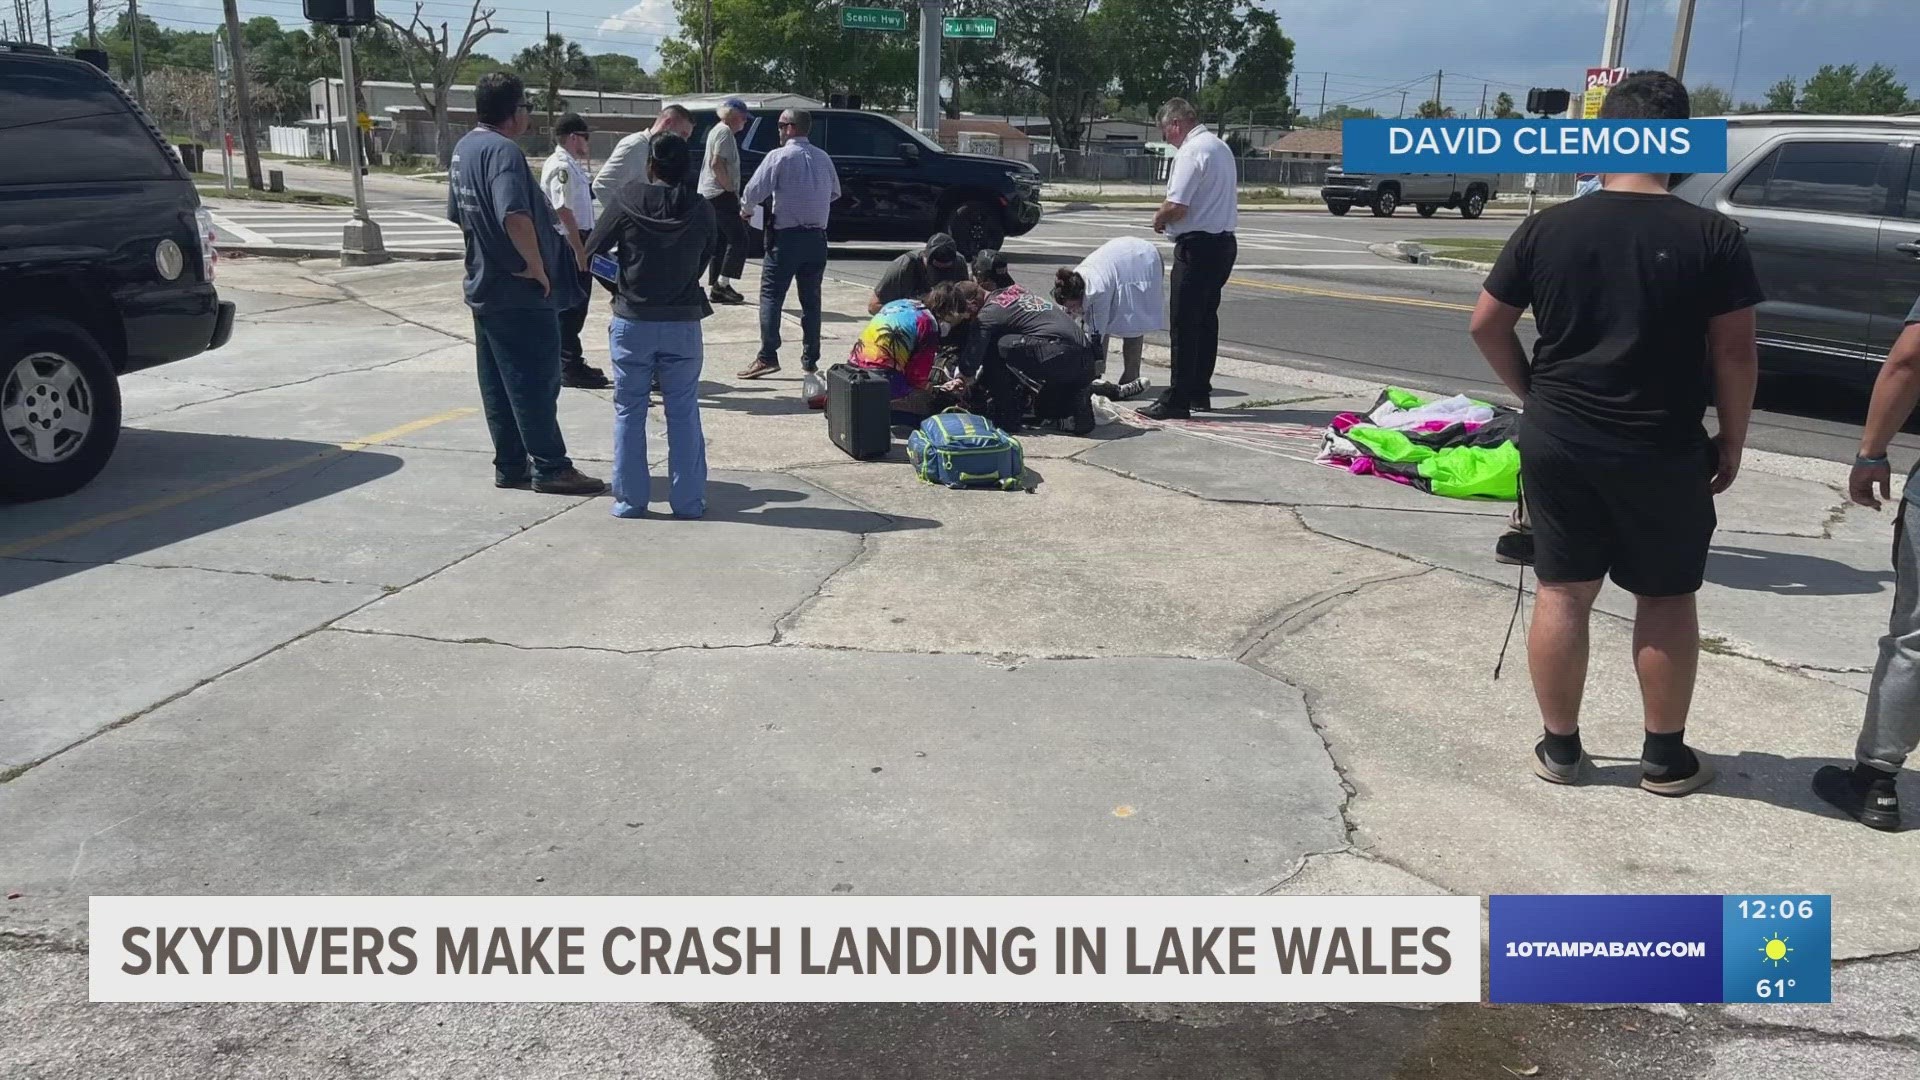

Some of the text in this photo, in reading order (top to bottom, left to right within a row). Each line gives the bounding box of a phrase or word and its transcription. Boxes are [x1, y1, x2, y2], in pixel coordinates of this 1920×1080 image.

[846, 12, 901, 27] Scenic Hwy
[945, 22, 953, 32] Dr
